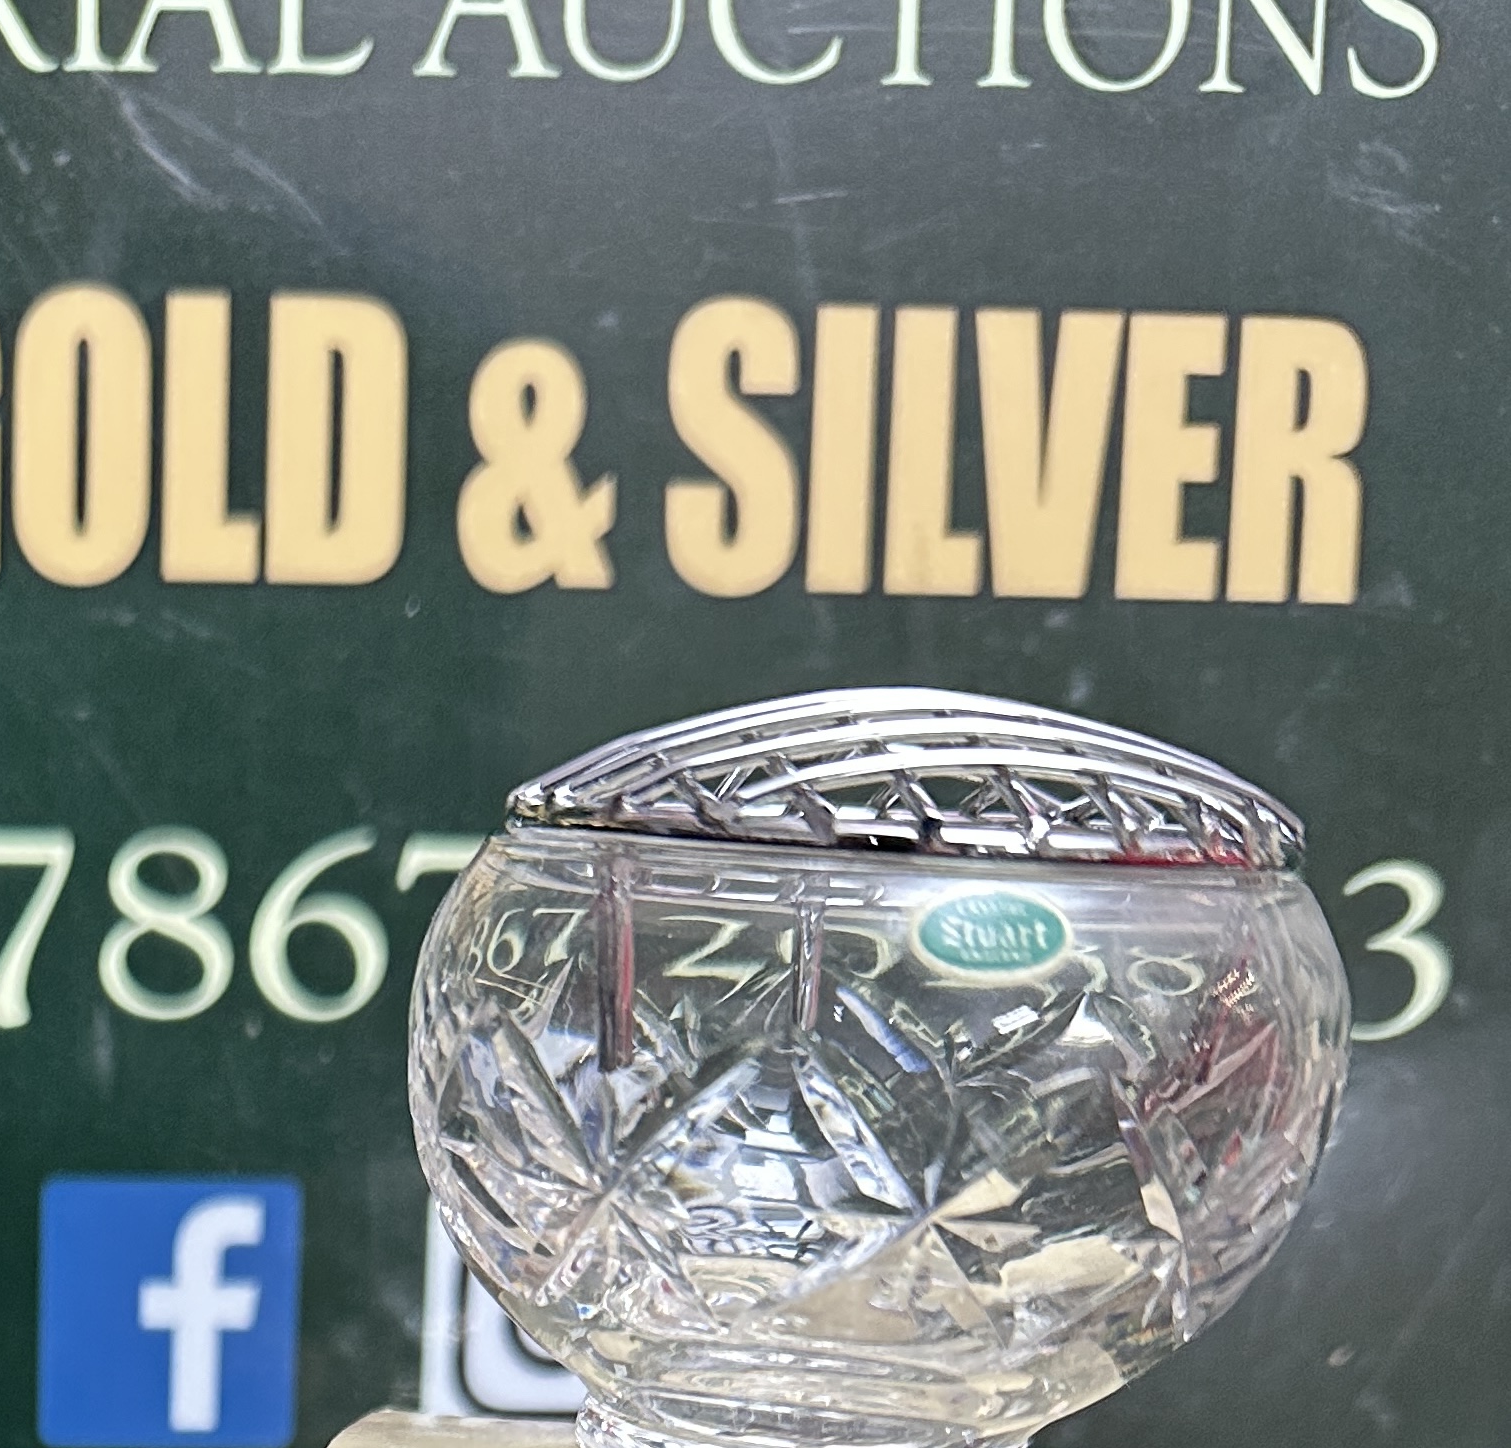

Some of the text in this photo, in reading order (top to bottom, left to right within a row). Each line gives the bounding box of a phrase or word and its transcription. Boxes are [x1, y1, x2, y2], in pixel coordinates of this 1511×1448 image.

[456, 338, 616, 595] &
[665, 295, 1370, 606] SILVER
[942, 915, 1048, 950] Stuart
